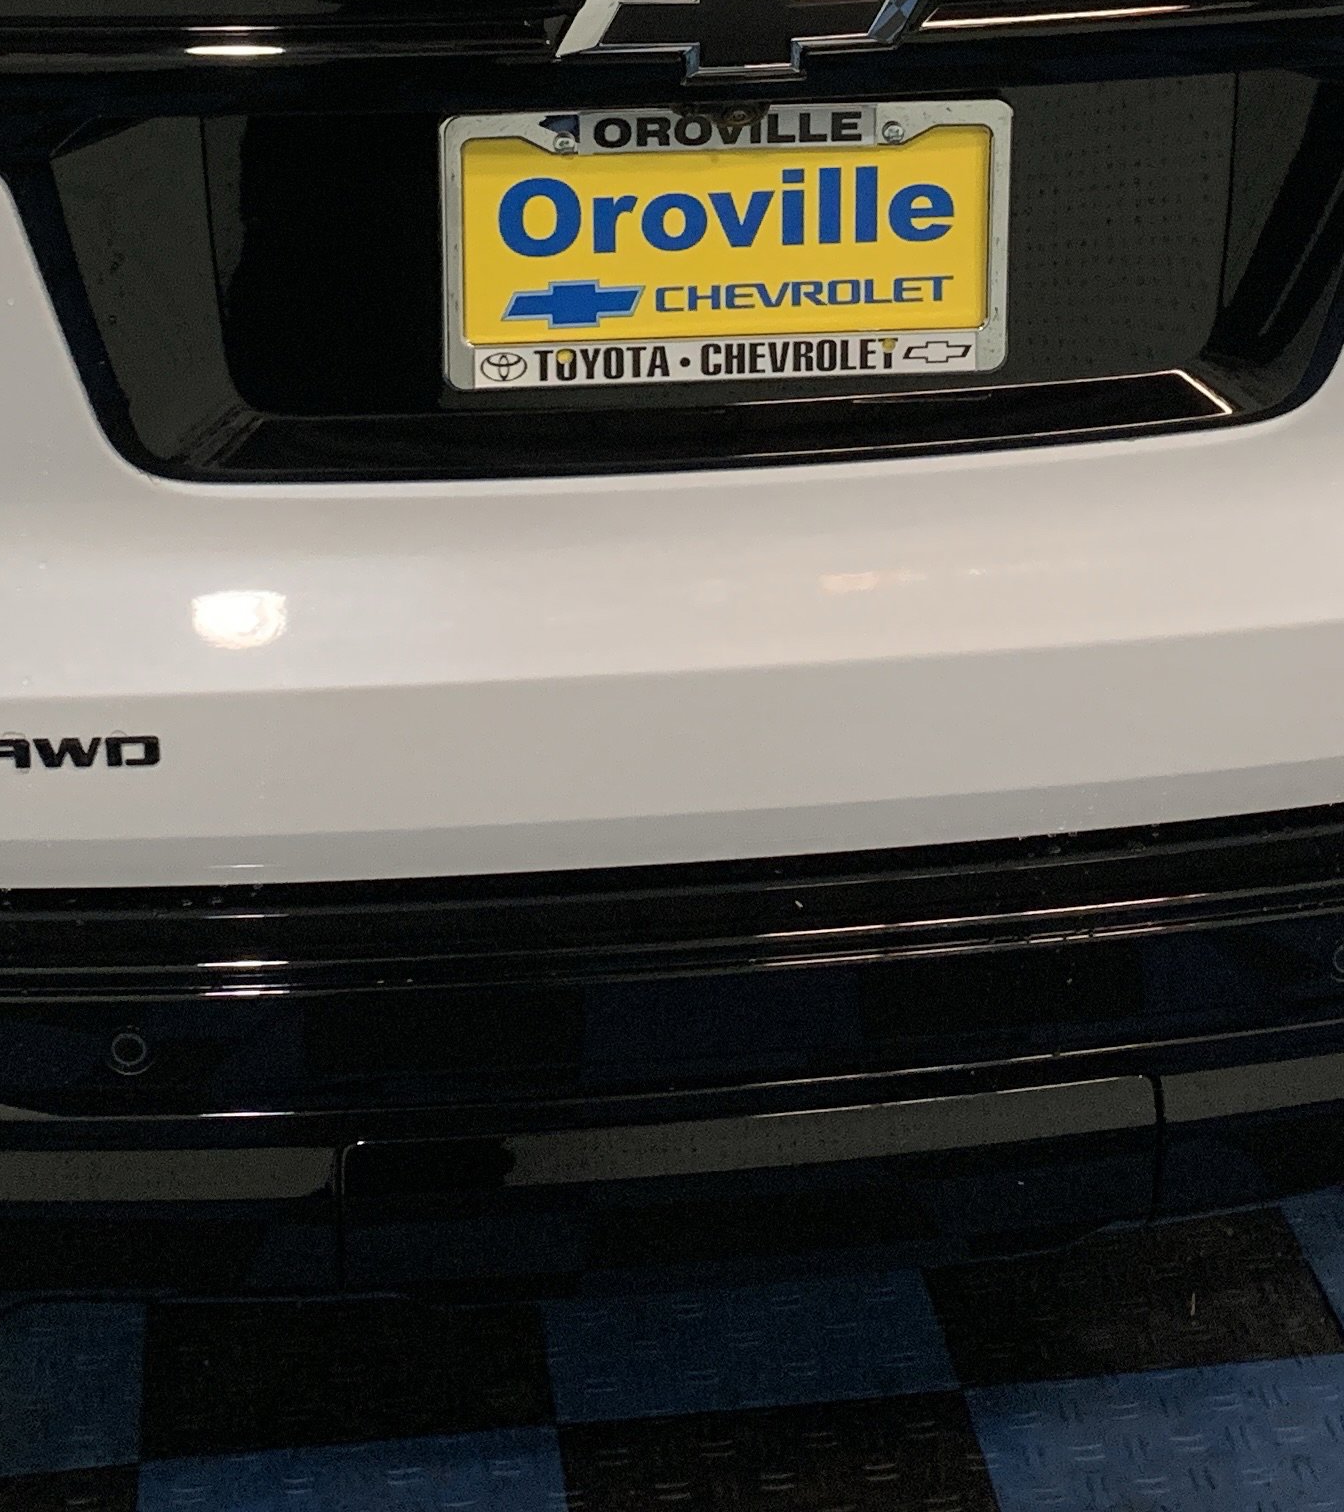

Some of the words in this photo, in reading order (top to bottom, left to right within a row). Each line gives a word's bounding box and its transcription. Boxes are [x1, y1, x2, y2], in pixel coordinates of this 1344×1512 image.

[593, 111, 862, 148] OROVILLE
[498, 165, 955, 258] Oroville
[655, 275, 955, 313] CHEVROLET
[533, 346, 671, 382] TOYOTA
[699, 337, 899, 376] CHEVROLET
